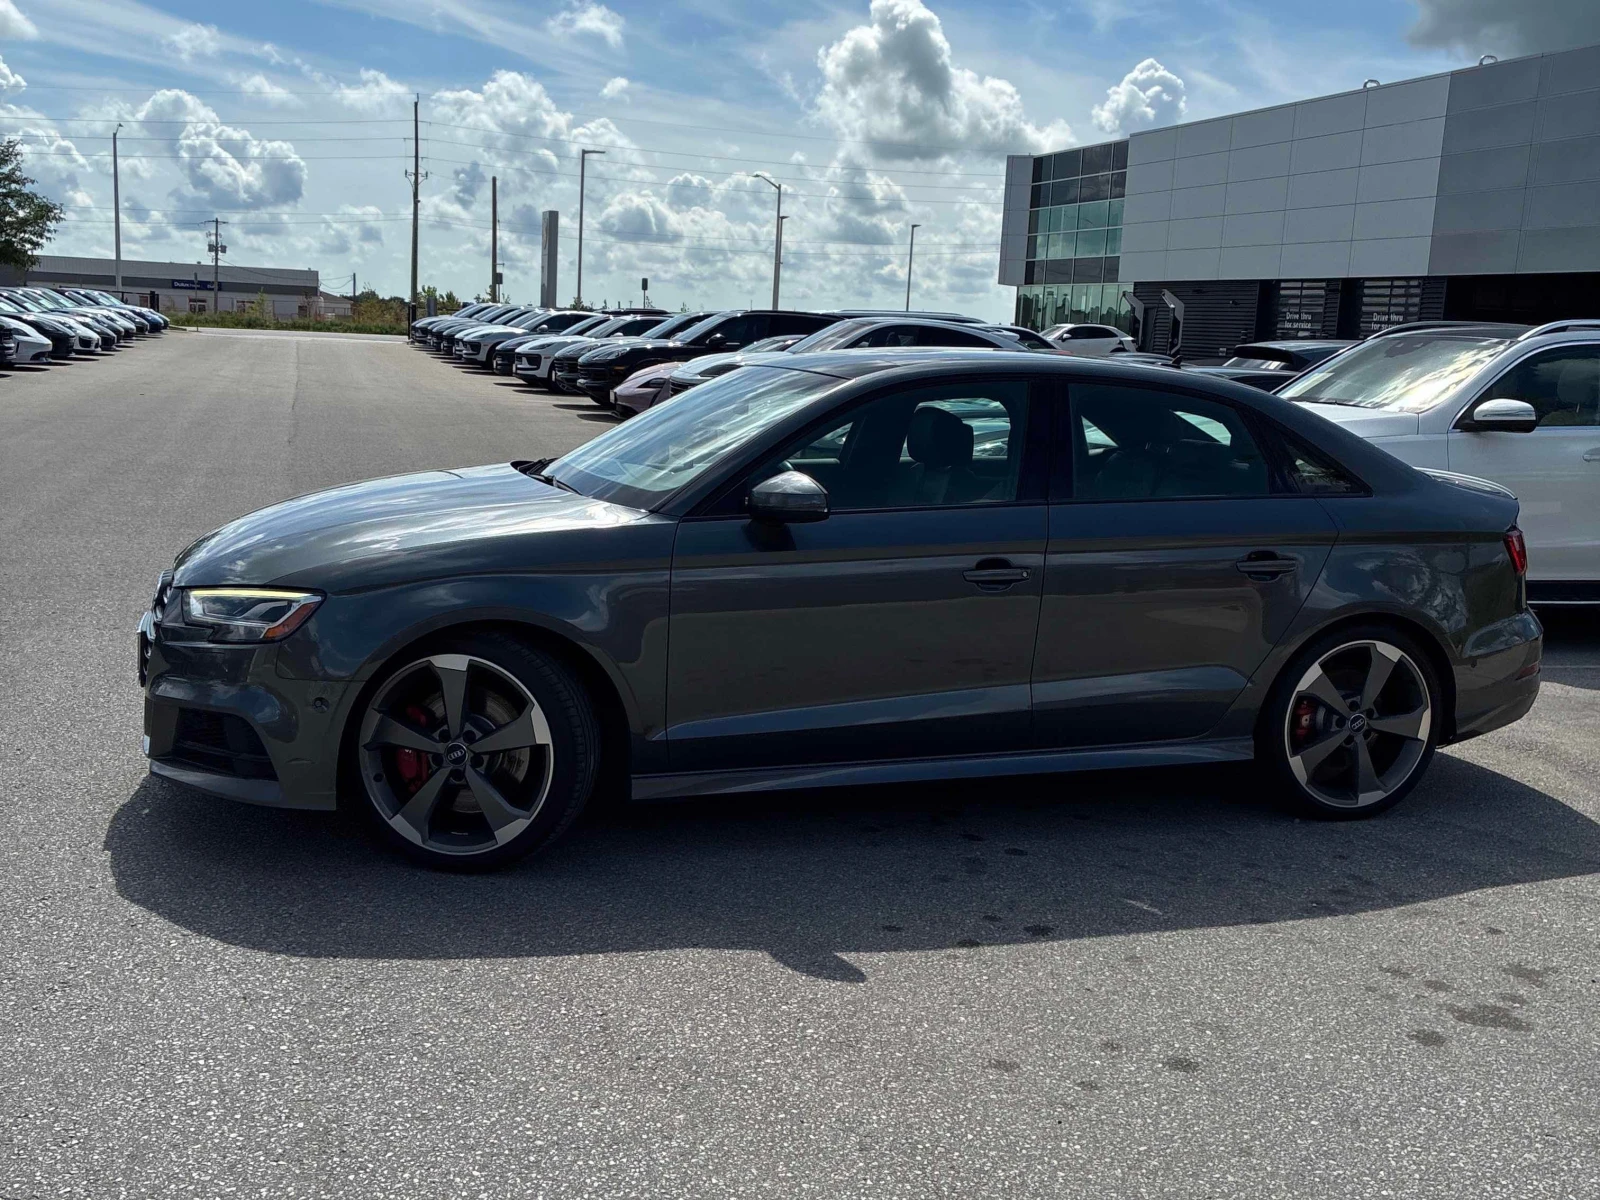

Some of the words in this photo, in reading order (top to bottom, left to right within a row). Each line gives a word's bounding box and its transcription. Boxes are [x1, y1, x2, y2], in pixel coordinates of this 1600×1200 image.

[1286, 312, 1299, 320] Drive
[1301, 312, 1312, 320] thru
[1373, 312, 1388, 321] Drive
[1390, 313, 1404, 321] thru
[1293, 321, 1312, 329] service
[1371, 322, 1380, 330] for
